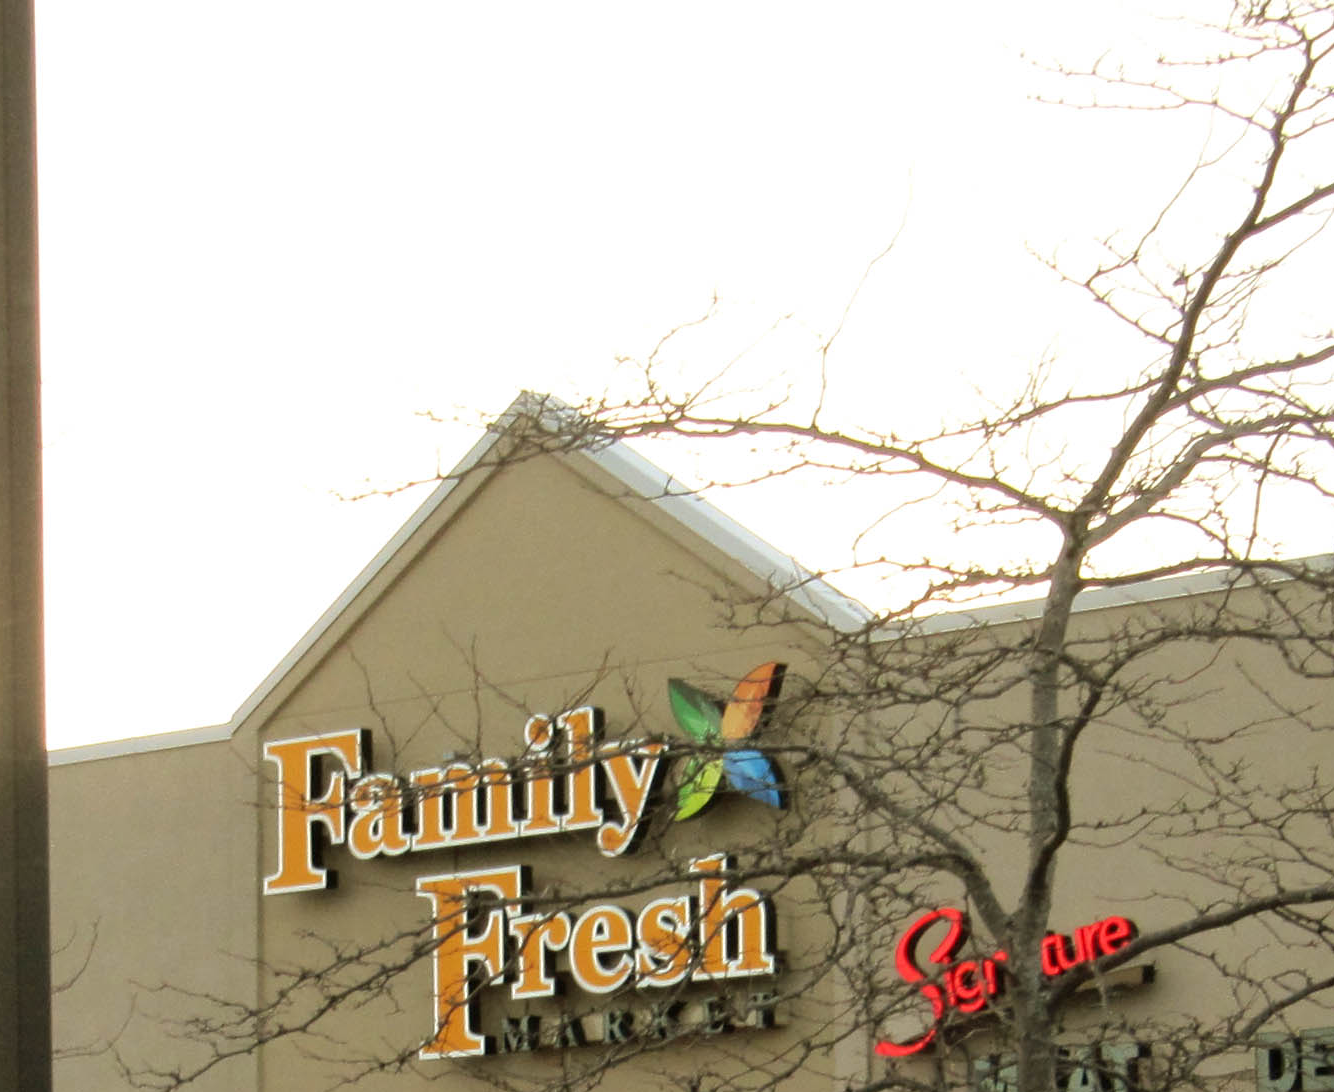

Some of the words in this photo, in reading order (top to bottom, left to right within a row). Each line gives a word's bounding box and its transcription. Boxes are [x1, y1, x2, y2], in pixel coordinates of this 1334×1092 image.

[264, 706, 668, 895] Family
[415, 853, 775, 1060] Fresh
[501, 990, 781, 1053] MARKET
[874, 907, 1133, 1057] Signture
